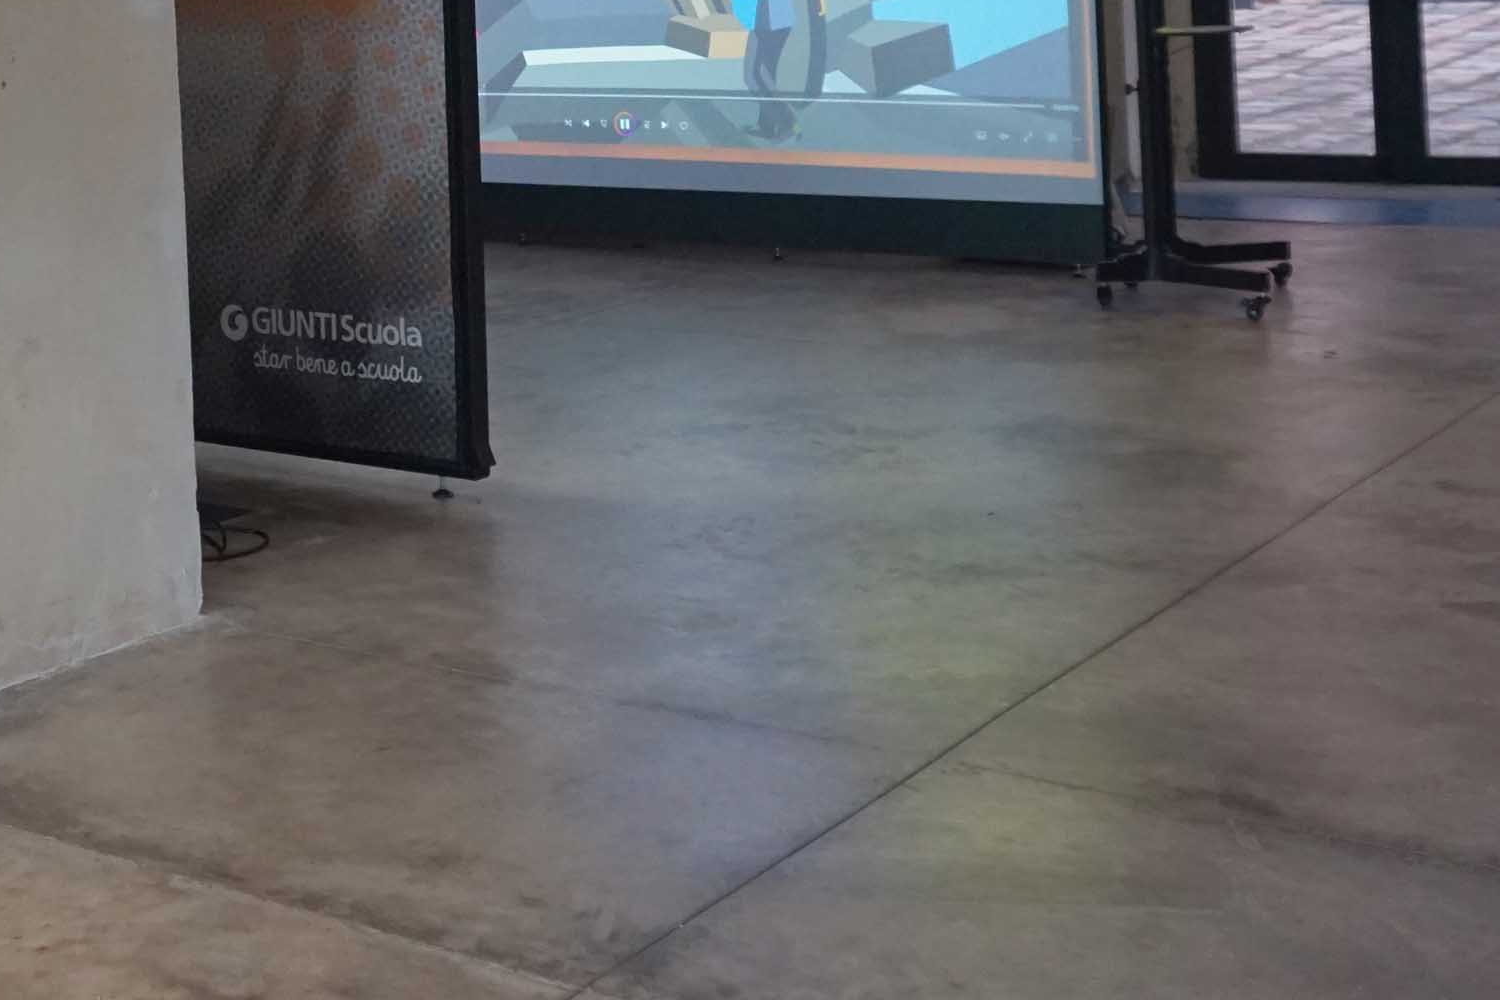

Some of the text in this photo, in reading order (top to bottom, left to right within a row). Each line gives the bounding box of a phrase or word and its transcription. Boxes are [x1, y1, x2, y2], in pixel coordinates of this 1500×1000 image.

[253, 344, 422, 384] star bene a scuola
